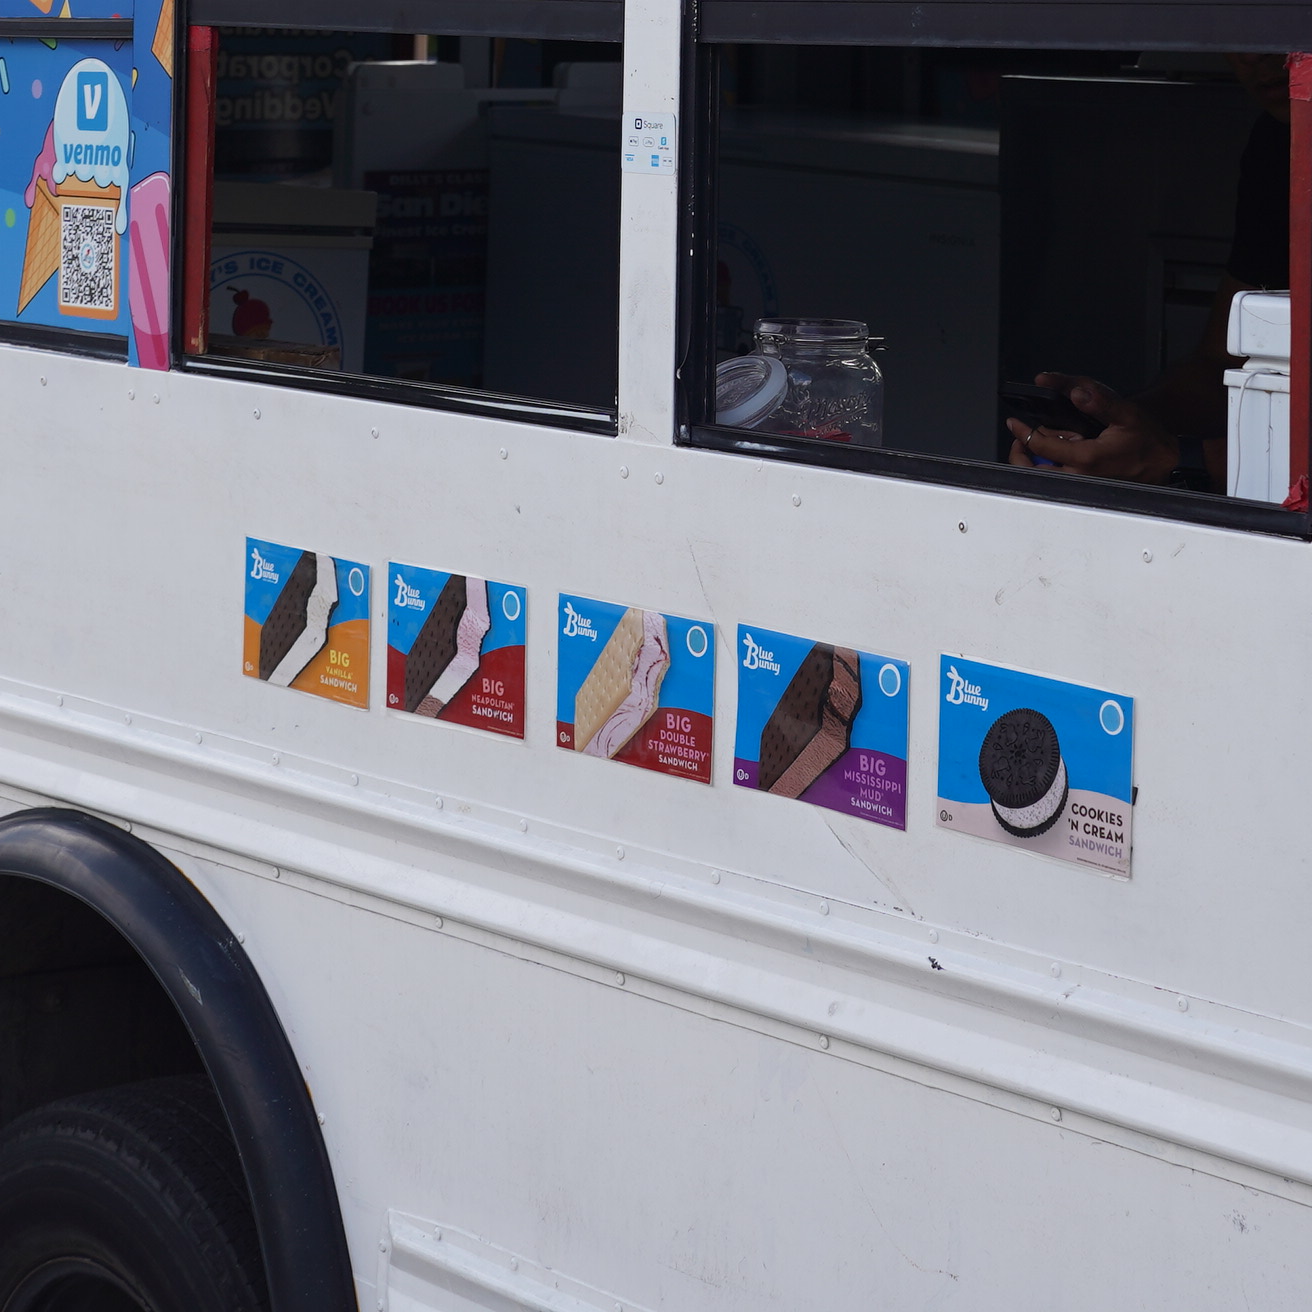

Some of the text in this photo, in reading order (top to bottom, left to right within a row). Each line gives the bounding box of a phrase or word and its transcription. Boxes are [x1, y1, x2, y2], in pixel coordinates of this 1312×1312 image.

[643, 120, 664, 130] Square
[63, 143, 122, 167] venmo
[249, 257, 284, 274] ICE
[292, 272, 338, 346] CREAM
[329, 649, 350, 667] BIG
[326, 666, 352, 680] VANILLA
[320, 675, 357, 693] SANDWICH
[482, 678, 504, 696] BIG
[471, 693, 513, 711] NEAPOLITAN
[472, 705, 514, 723] SANDWICH
[666, 713, 692, 732] BIG
[660, 729, 696, 747] DOUBLE
[648, 739, 707, 762] STRAWBERRY
[658, 754, 698, 771] SANDWICH
[859, 754, 886, 776] BIG
[844, 770, 901, 794] MISSISSIPPI
[859, 787, 882, 802] MUD
[850, 797, 892, 817] SANDWICH
[1071, 803, 1123, 827] COOKIES
[1068, 818, 1124, 844] 'N CREAM
[1068, 836, 1123, 859] SANDWICH
